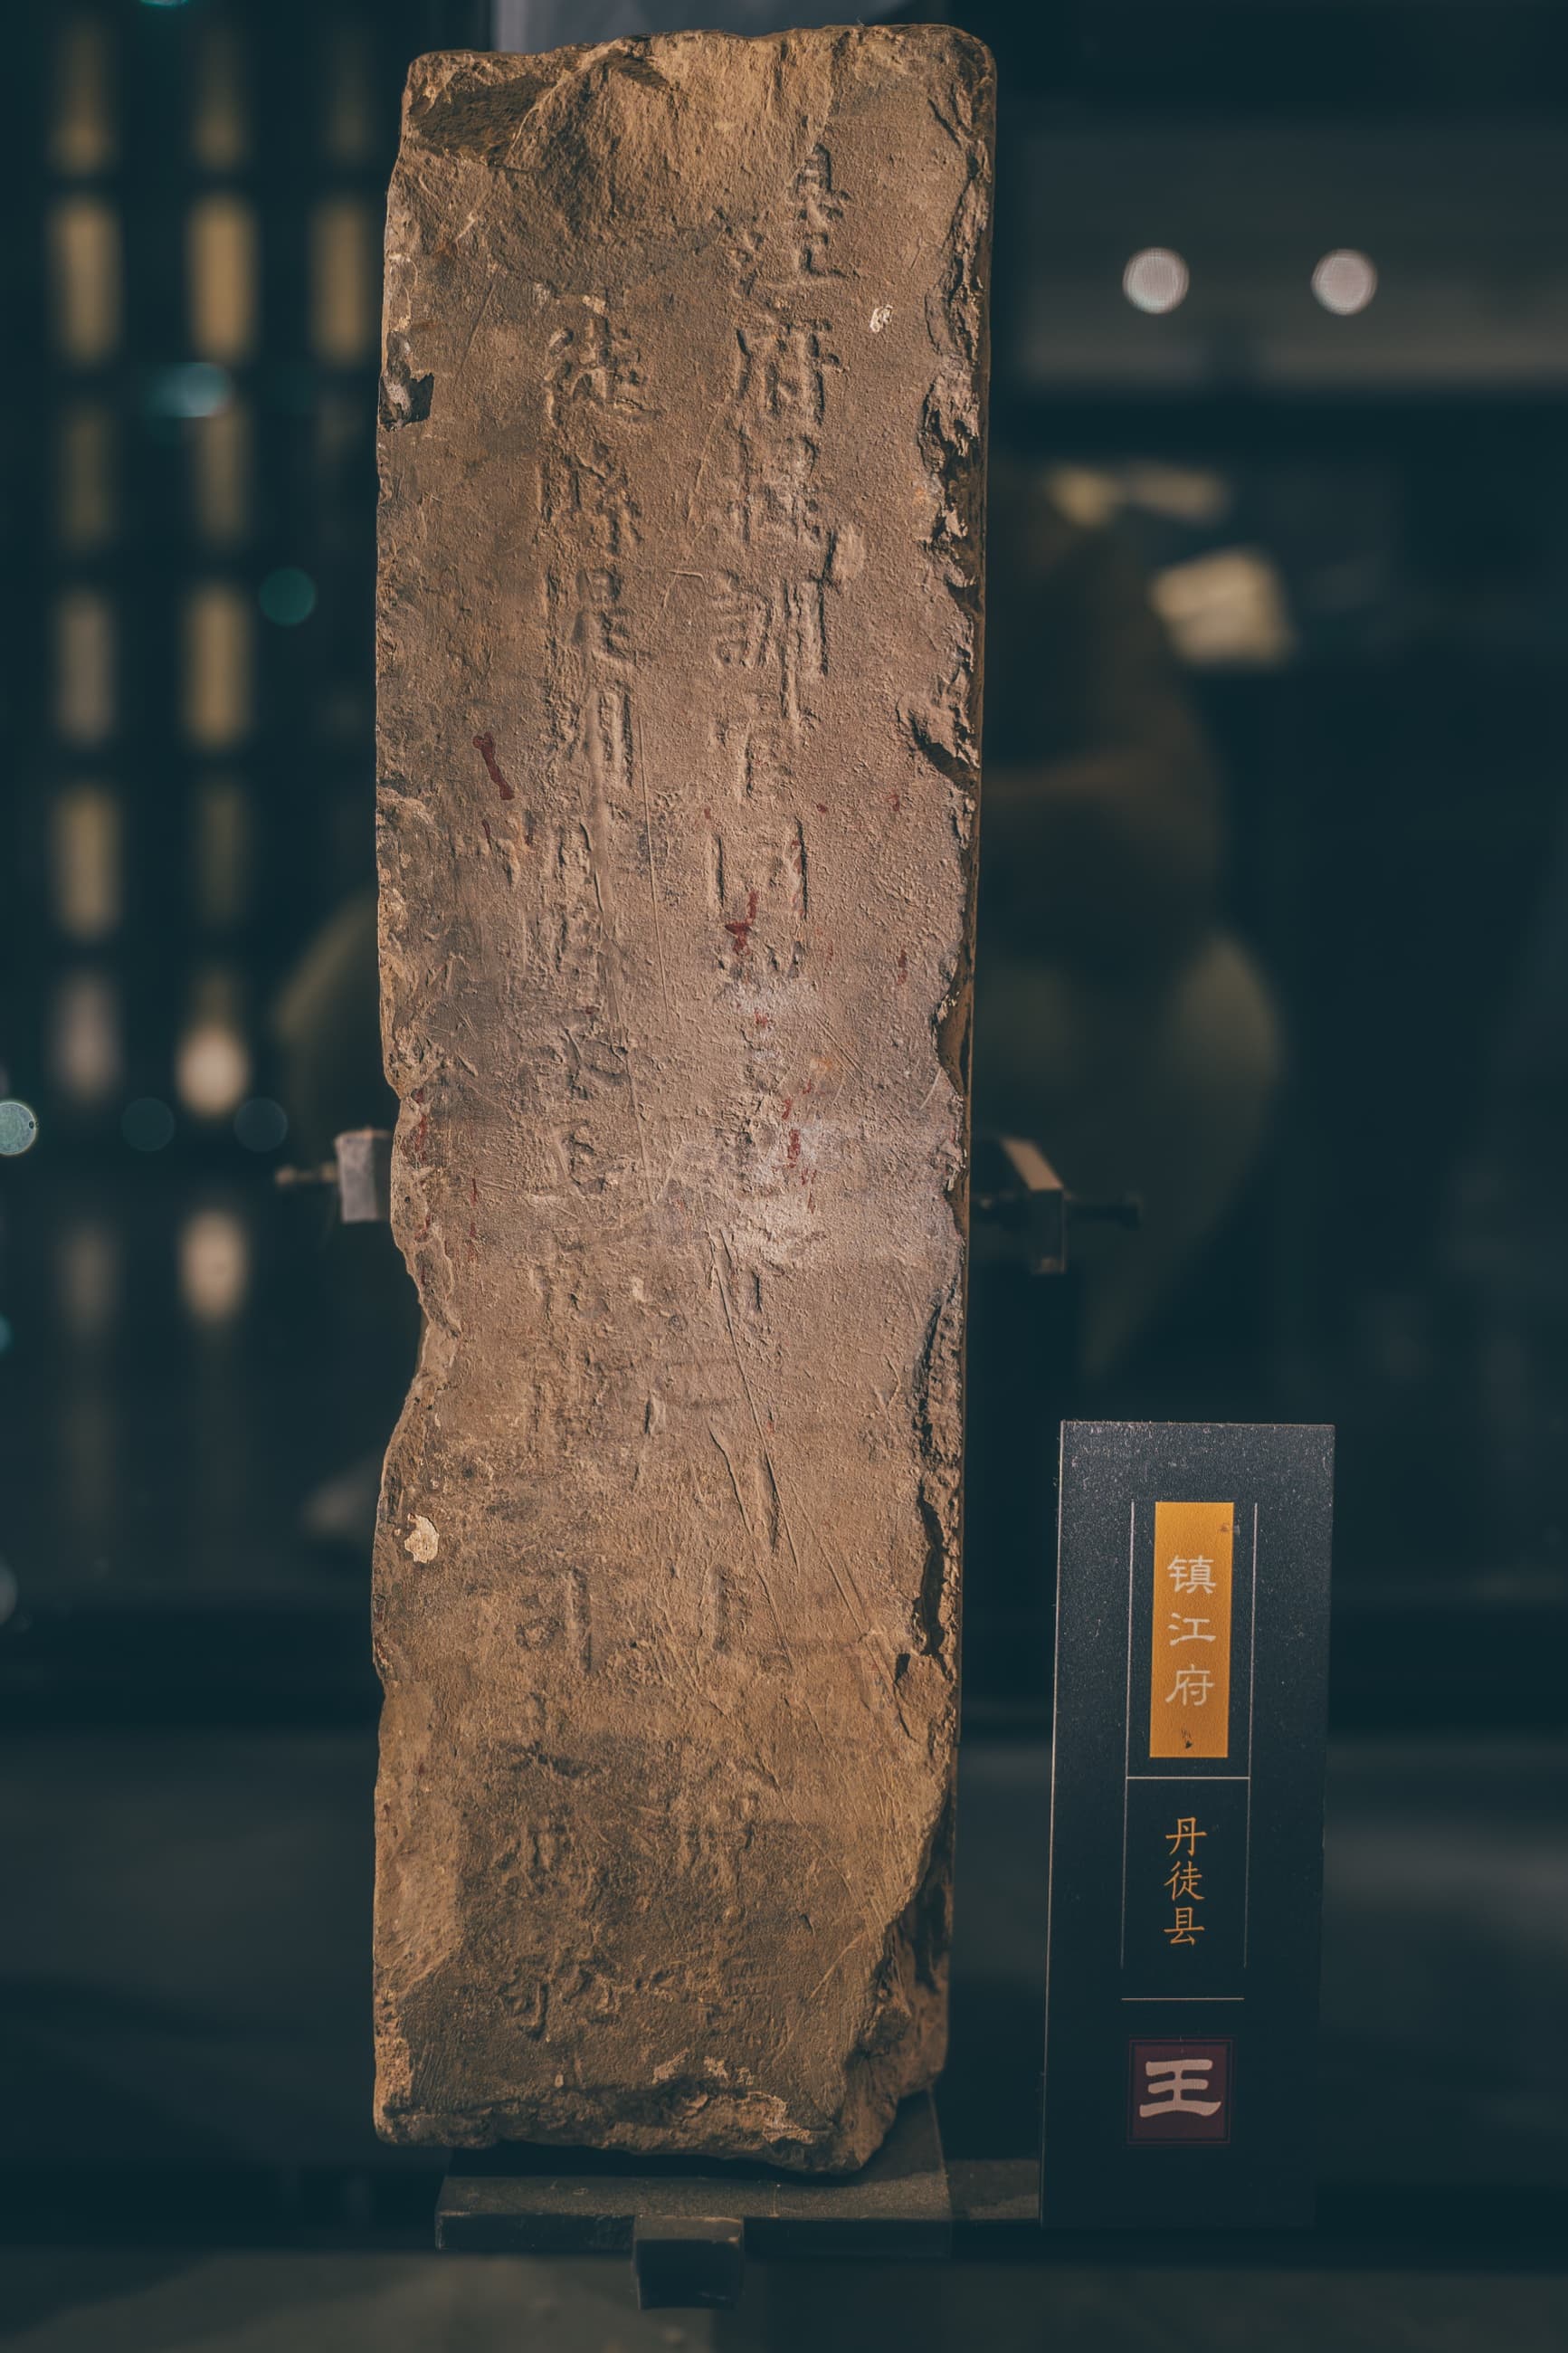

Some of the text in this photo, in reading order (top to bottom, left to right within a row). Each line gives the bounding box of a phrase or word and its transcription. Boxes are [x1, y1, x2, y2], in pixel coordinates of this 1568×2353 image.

[1165, 1555, 1217, 1707] 镇江府
[1164, 1816, 1207, 1946] 丹徒县
[1138, 2059, 1221, 2118] 王
